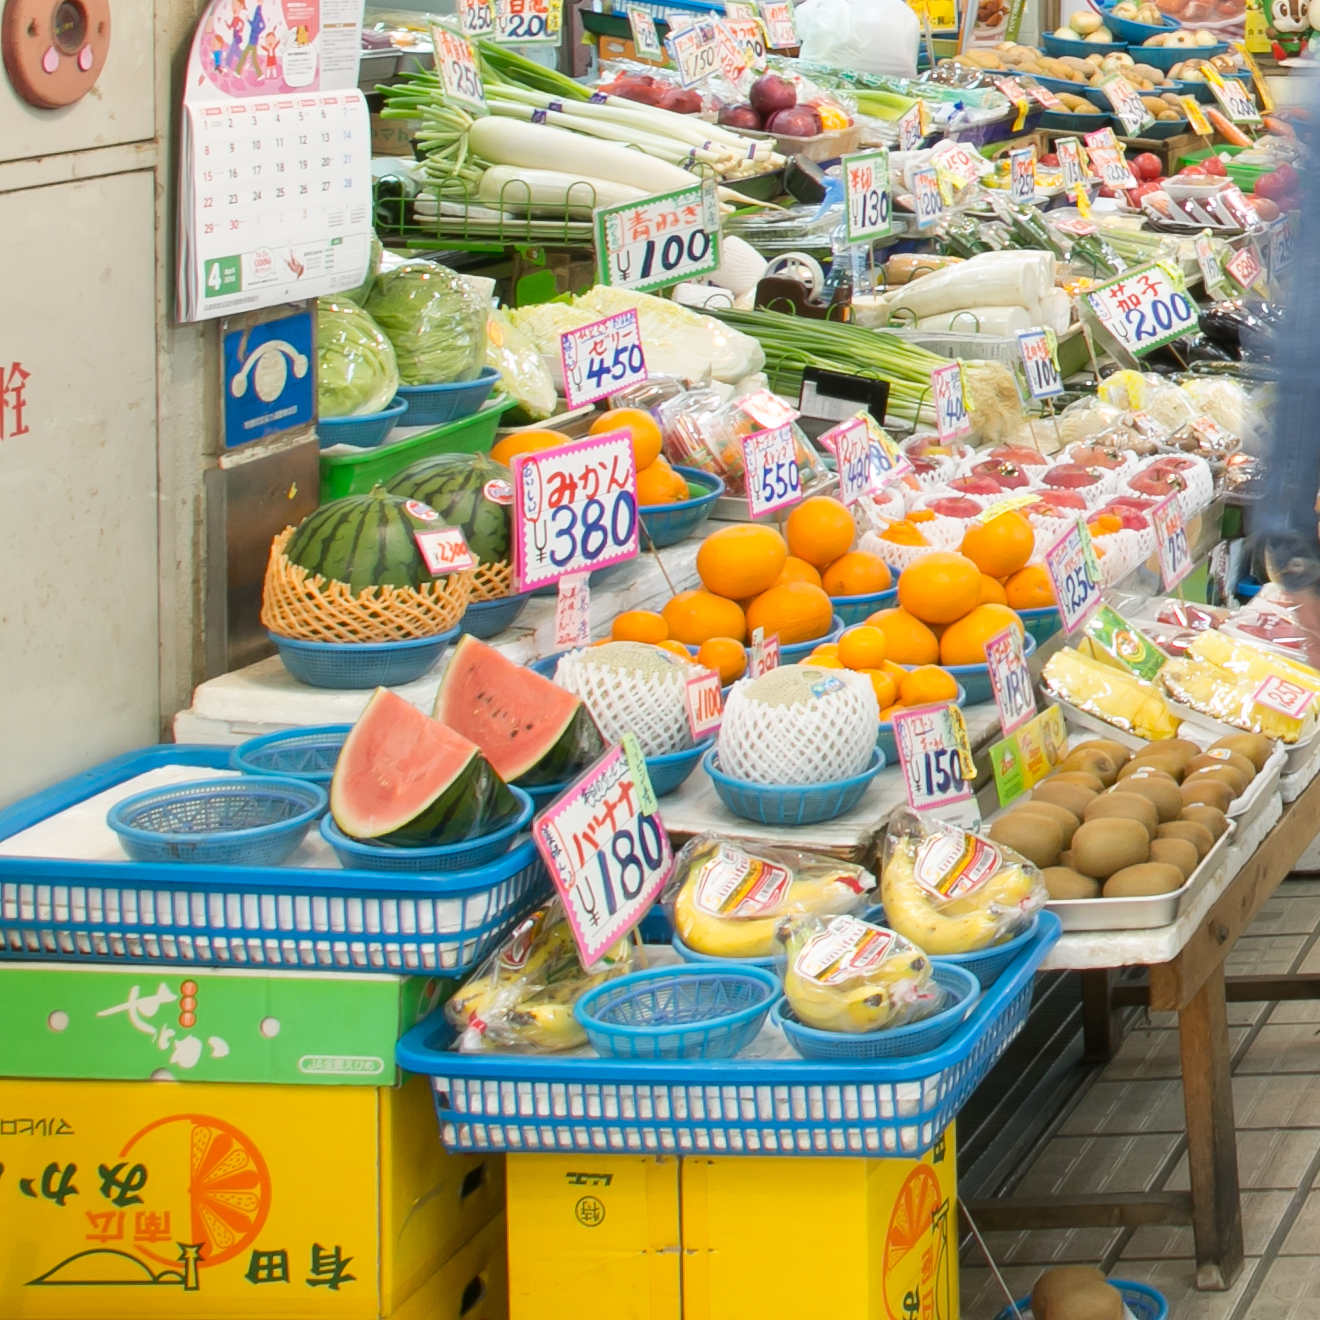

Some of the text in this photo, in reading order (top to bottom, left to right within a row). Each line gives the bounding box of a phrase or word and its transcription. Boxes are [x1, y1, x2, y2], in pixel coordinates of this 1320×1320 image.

[628, 203, 702, 242] 青ねぎ
[851, 190, 890, 229] ¥130
[207, 262, 222, 291] 4
[616, 228, 711, 282] ¥100
[1109, 274, 1163, 313] 茄子
[1111, 292, 1192, 345] ¥200
[571, 342, 645, 393] ¥450
[588, 330, 634, 357] ゼリー
[545, 455, 631, 509] みかん
[533, 489, 636, 569] ¥380
[1267, 680, 1307, 708] 250
[572, 780, 635, 869] バナナ
[575, 810, 664, 927] ¥180
[0, 1161, 149, 1208] みか
[243, 1242, 358, 1291] 有田
